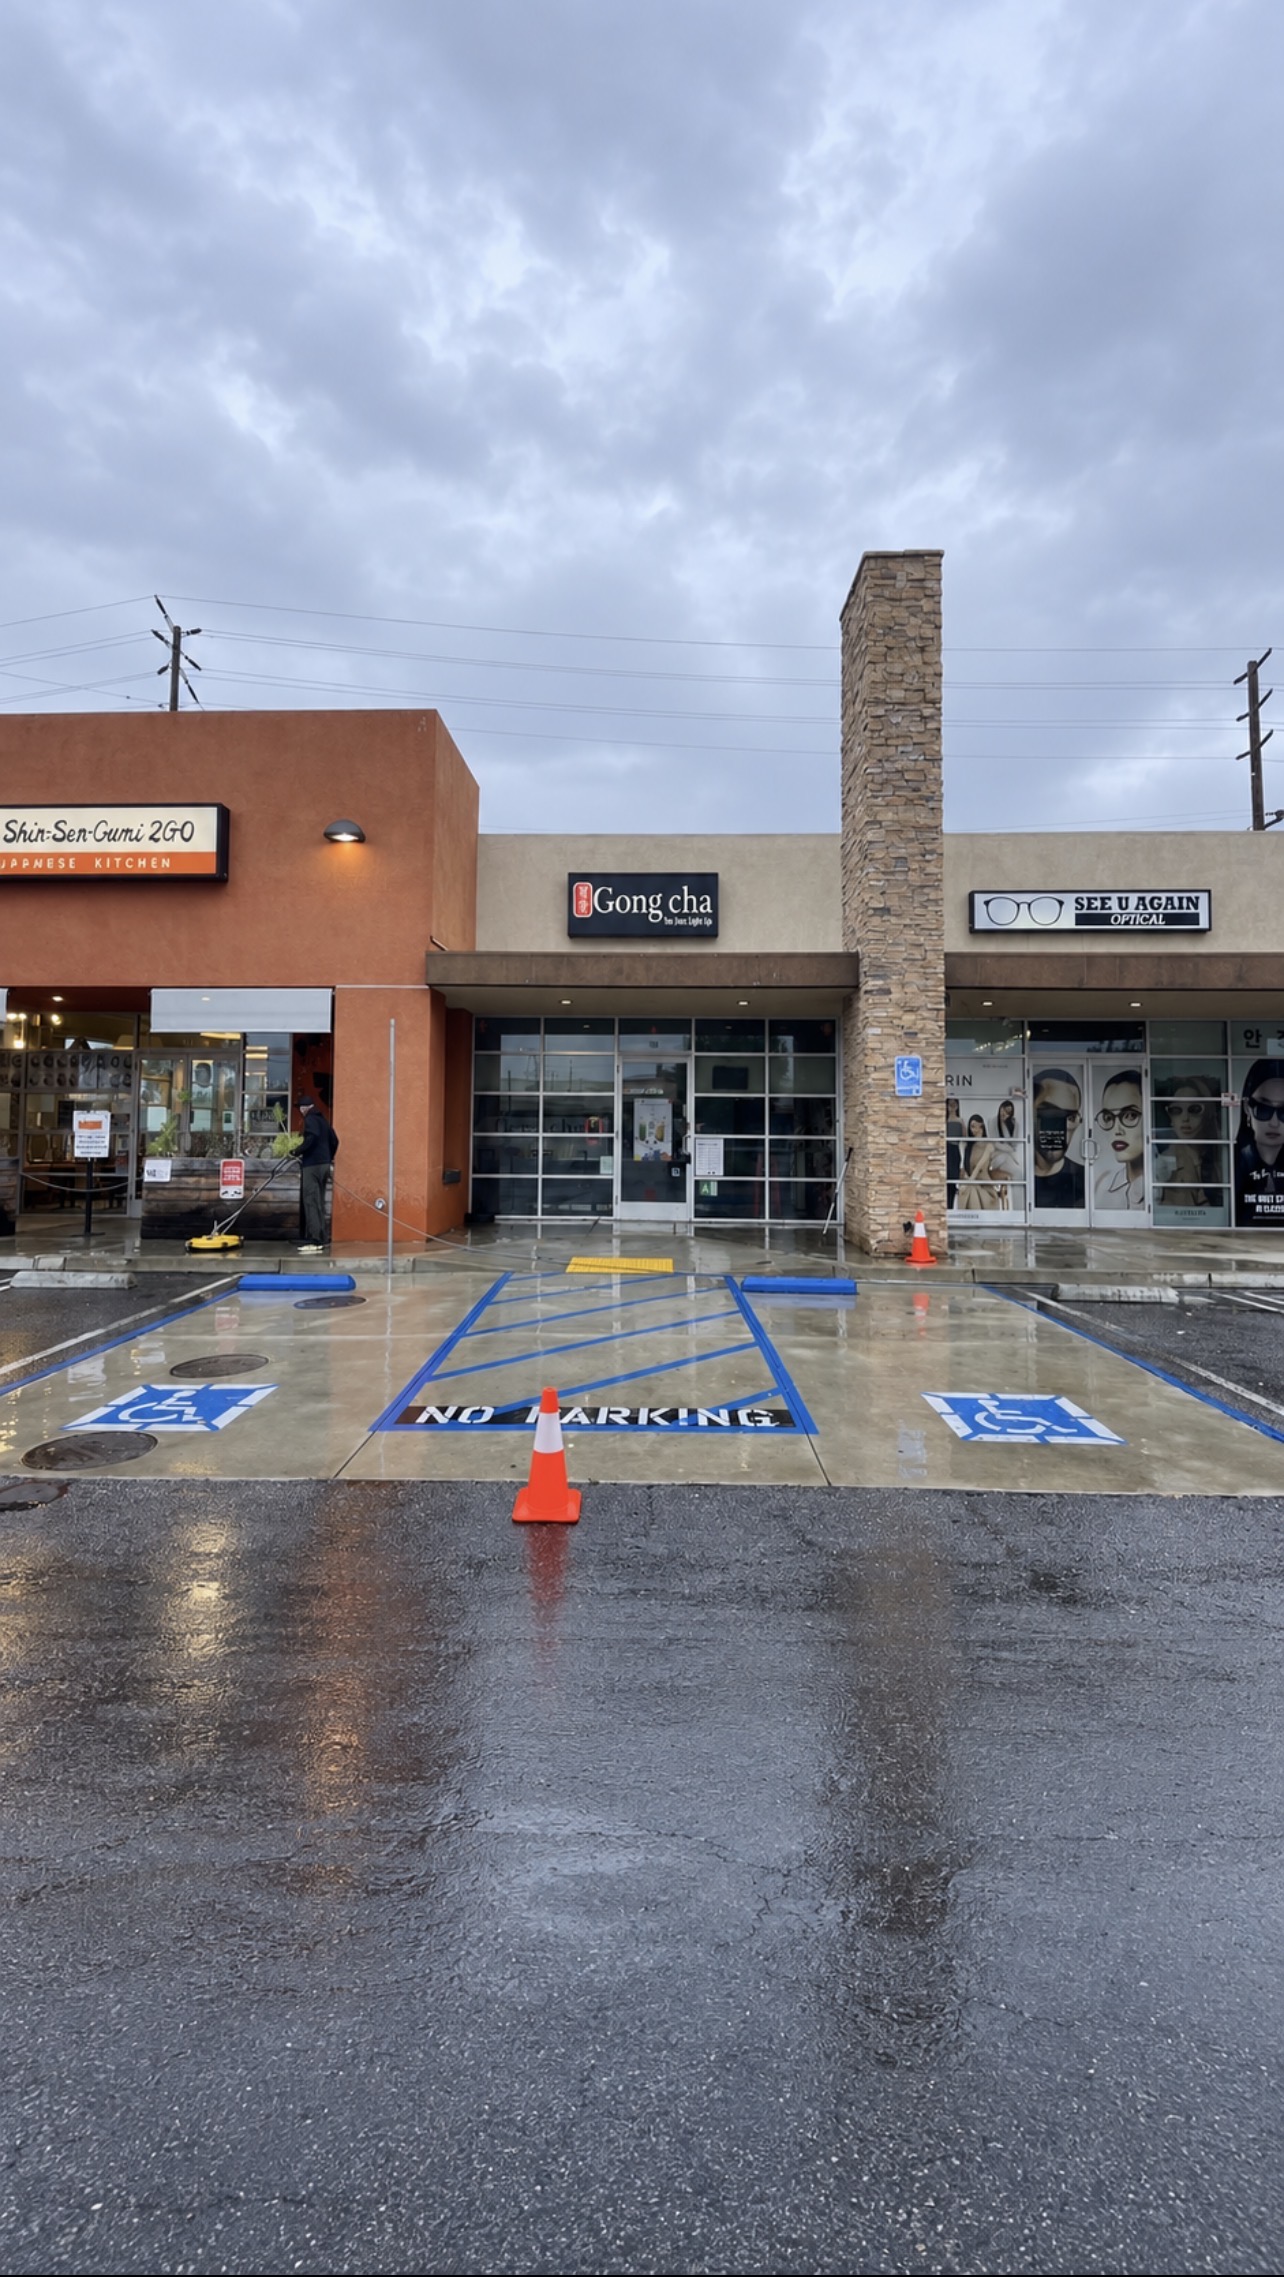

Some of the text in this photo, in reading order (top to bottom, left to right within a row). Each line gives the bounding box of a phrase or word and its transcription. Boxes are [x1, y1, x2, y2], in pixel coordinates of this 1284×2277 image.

[148, 820, 195, 843] 2GO
[94, 857, 171, 869] KITCHEN
[593, 886, 663, 923] Gong
[668, 885, 713, 914] cha
[1074, 896, 1200, 911] SEE U AGAIN
[1110, 913, 1166, 926] OPTICAL
[415, 1406, 495, 1424] NO
